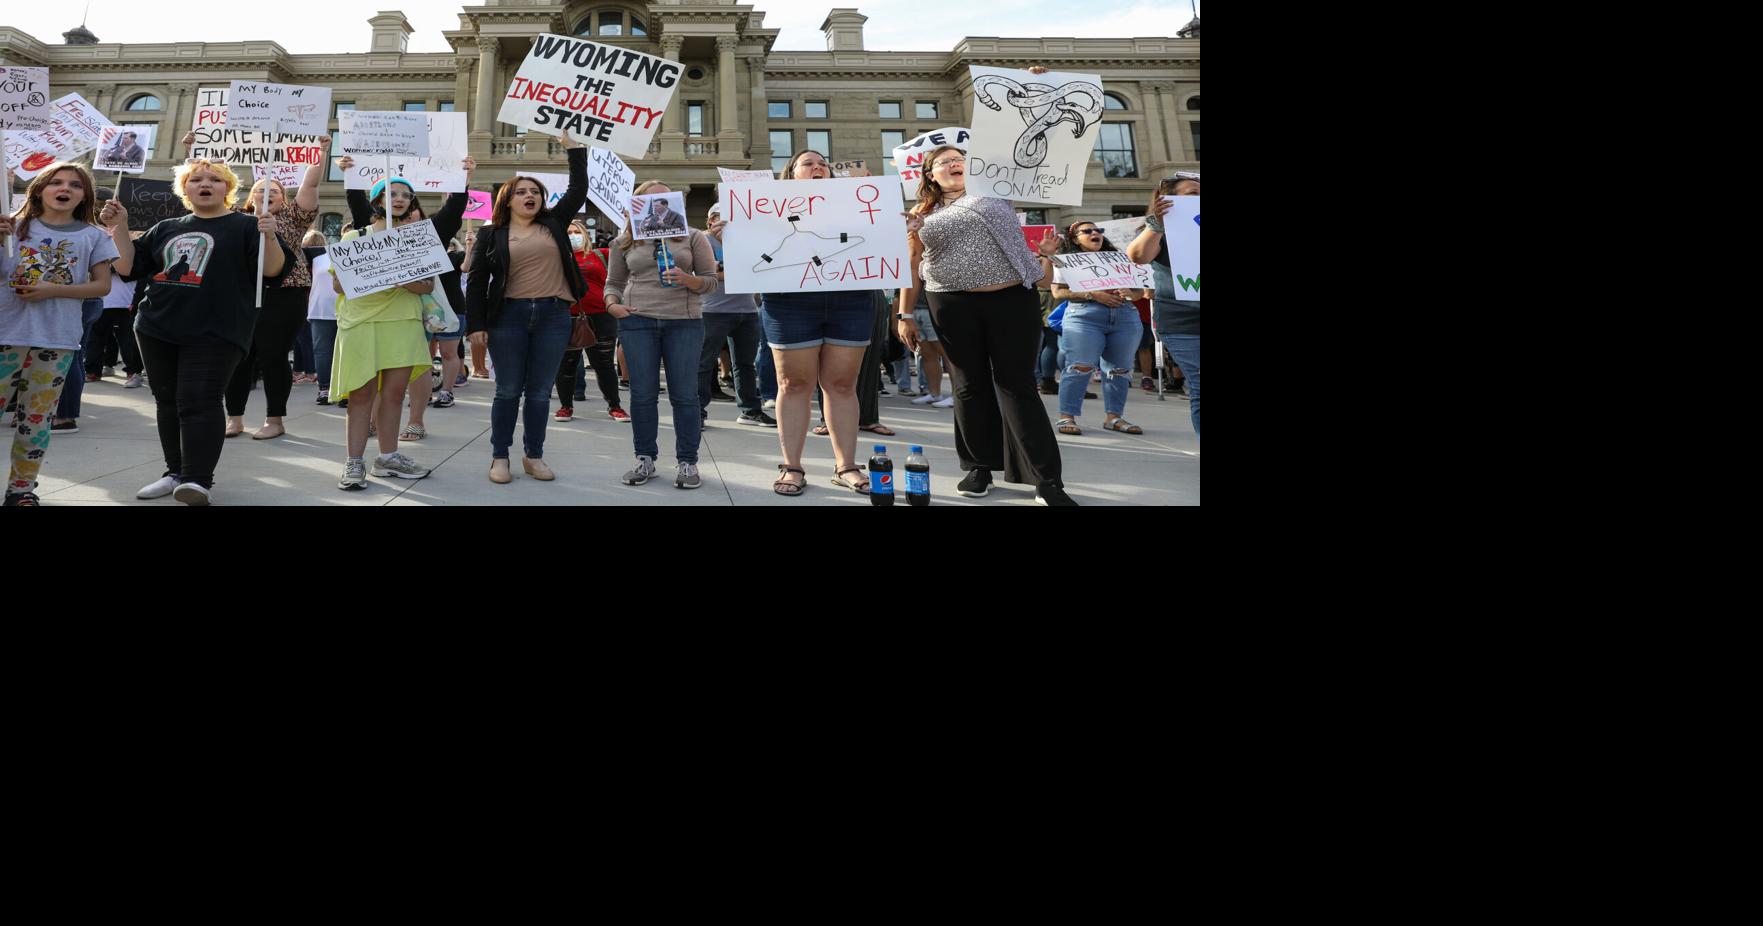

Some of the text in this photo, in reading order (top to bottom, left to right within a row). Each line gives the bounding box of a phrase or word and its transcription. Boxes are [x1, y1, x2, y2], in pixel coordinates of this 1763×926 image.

[533, 36, 679, 88] WYOMING
[574, 74, 615, 96] THE
[238, 99, 269, 108] Choice
[508, 77, 663, 129] INEQUALITY
[534, 105, 614, 142] STATE
[195, 128, 252, 144] SOME
[591, 149, 630, 192] UTERUS
[607, 151, 623, 172] NO
[600, 172, 619, 194] NO
[1032, 163, 1069, 185] Tread
[131, 183, 173, 208] Keep
[992, 180, 1053, 198] ON ME
[730, 188, 825, 222] Never
[407, 261, 441, 278] EVERYONE
[800, 256, 899, 288] AGAIN
[1064, 253, 1094, 269] WHAT
[1082, 265, 1109, 278] TO
[1080, 276, 1137, 289] EQUALITY
